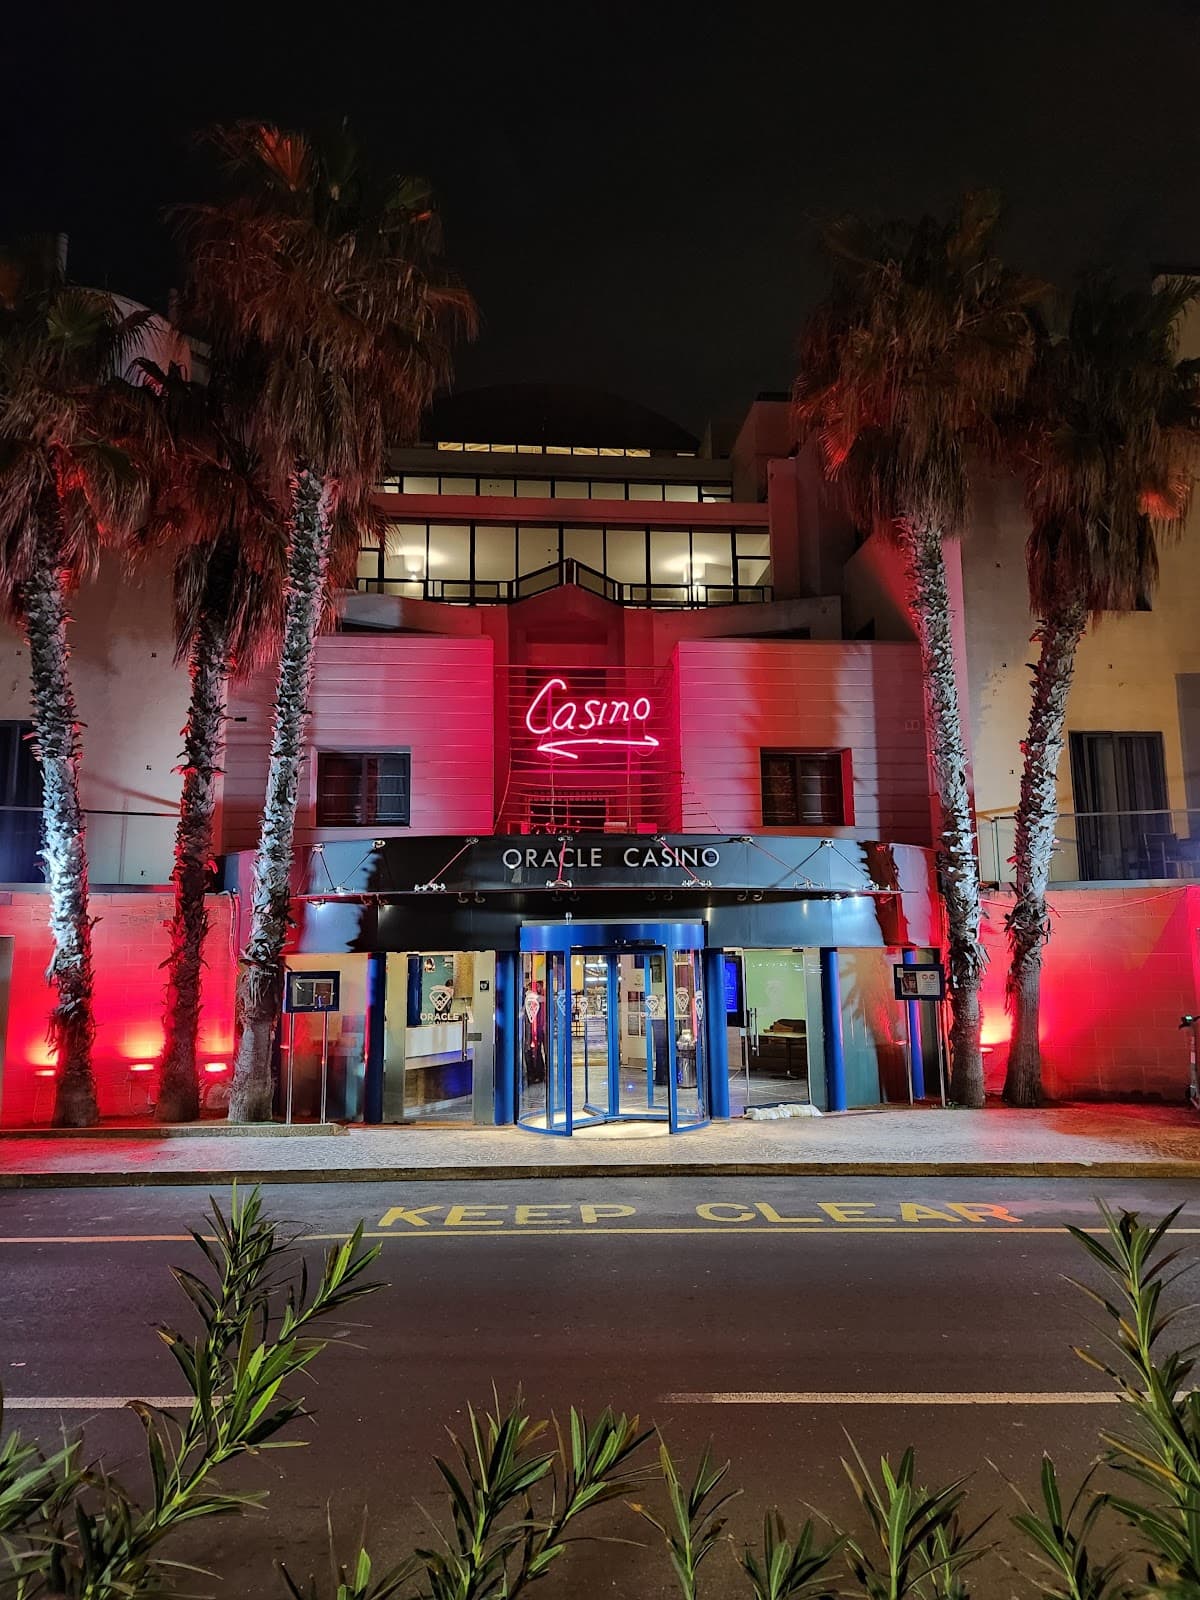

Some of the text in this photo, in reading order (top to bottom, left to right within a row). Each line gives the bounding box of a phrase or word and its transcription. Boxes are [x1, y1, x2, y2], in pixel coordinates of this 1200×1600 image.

[525, 678, 651, 735] Casino
[502, 847, 720, 868] ORACLE CASINO
[420, 1012, 460, 1021] ORACLE
[377, 1202, 1023, 1227] KEEP CLEAR
